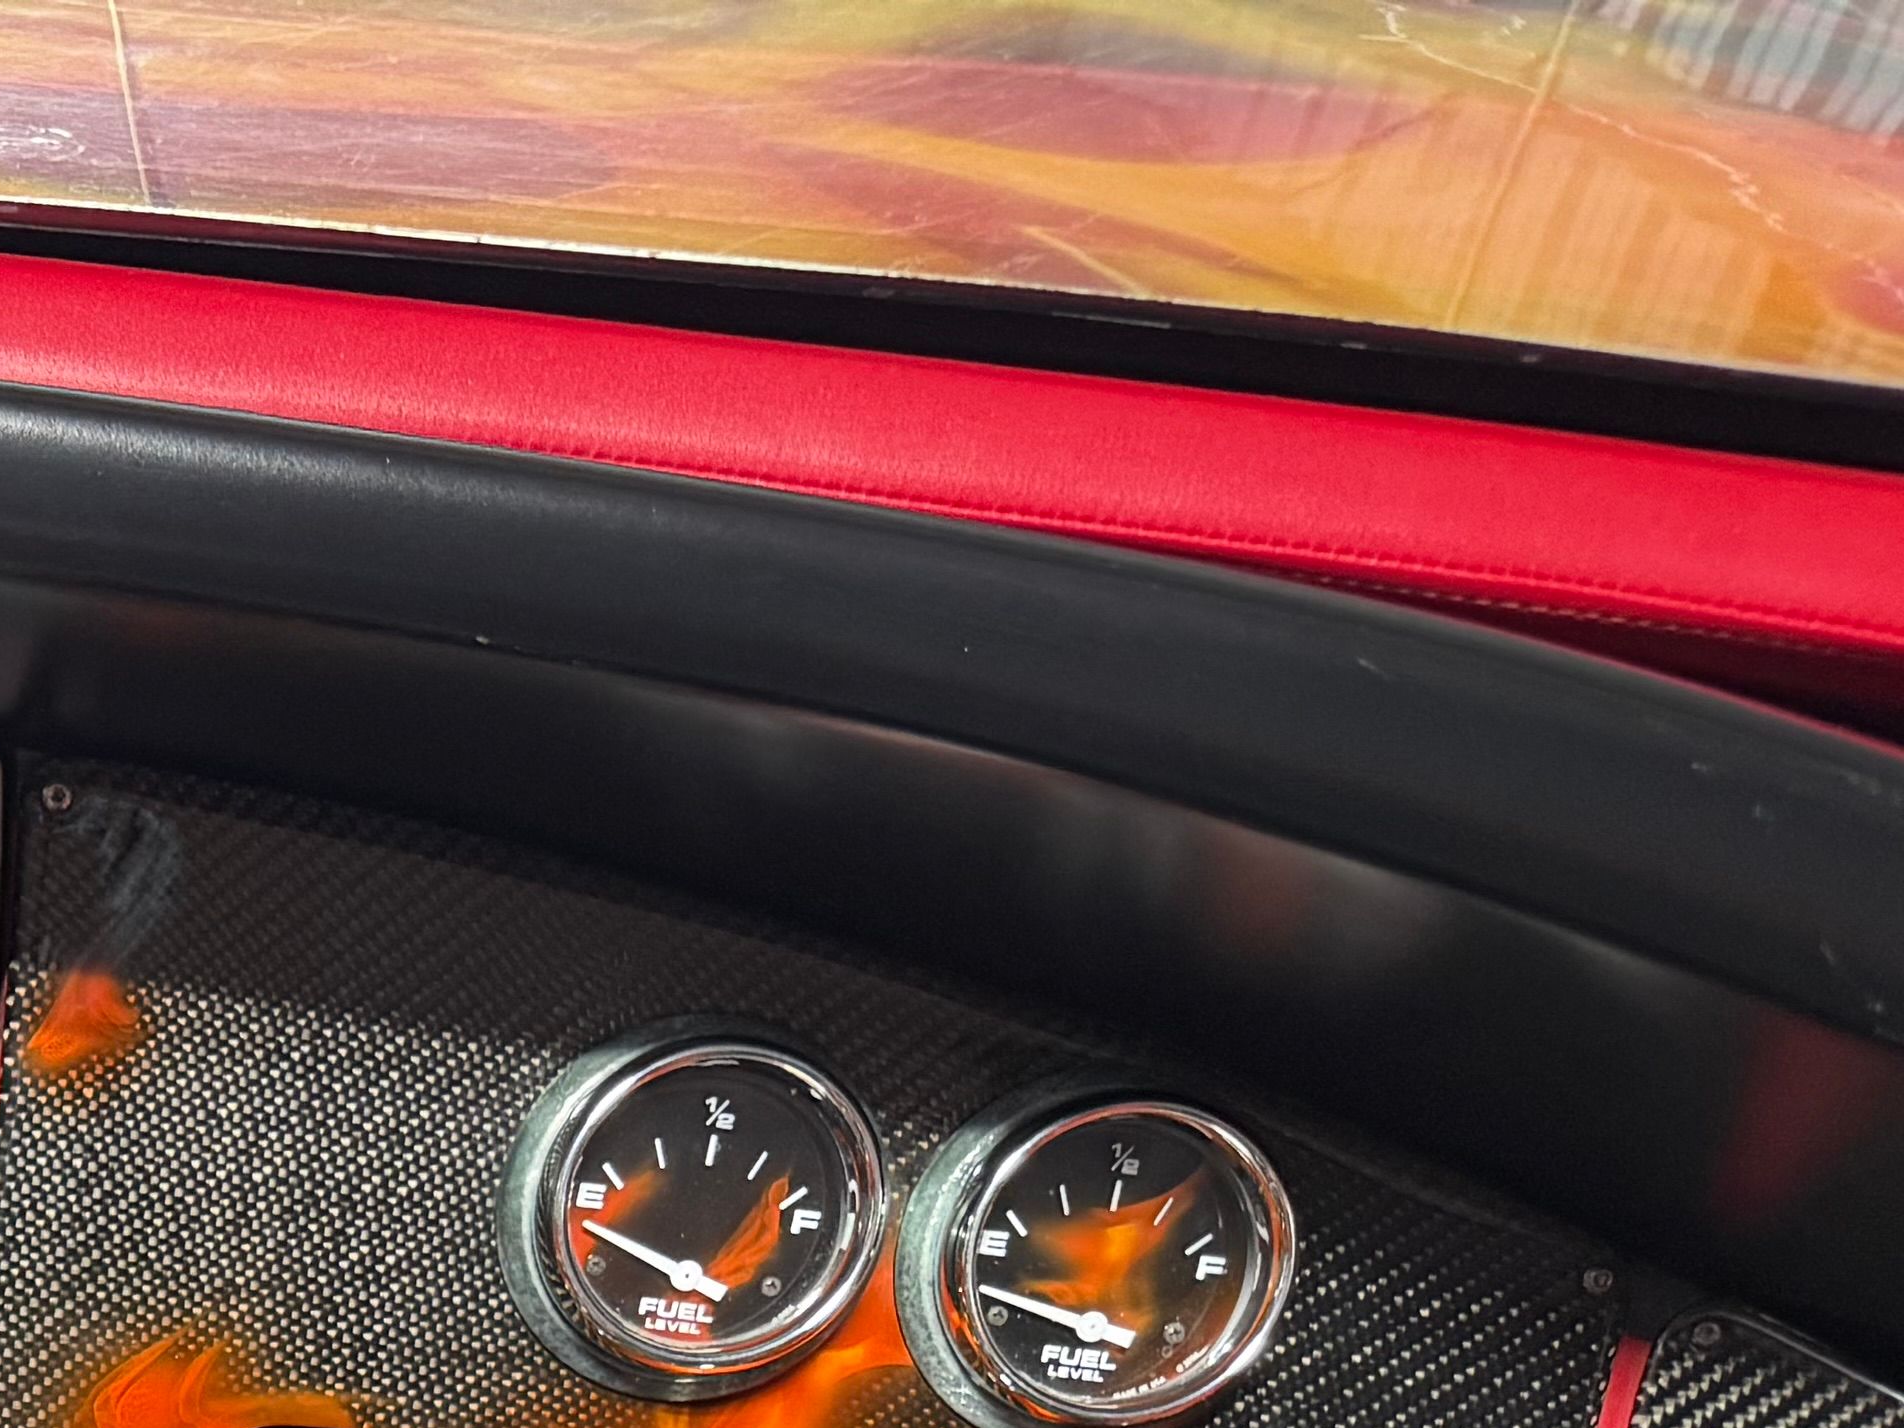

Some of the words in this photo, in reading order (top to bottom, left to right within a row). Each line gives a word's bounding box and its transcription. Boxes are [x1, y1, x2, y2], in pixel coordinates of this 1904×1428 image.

[576, 1182, 607, 1210] E
[790, 1209, 822, 1235] F
[977, 1229, 1010, 1258] E
[1195, 1255, 1227, 1281] F
[638, 1296, 714, 1324] FUEL
[644, 1317, 701, 1335] LEVEL
[1041, 1345, 1117, 1371] FUEL
[1047, 1364, 1104, 1384] LEVEL
